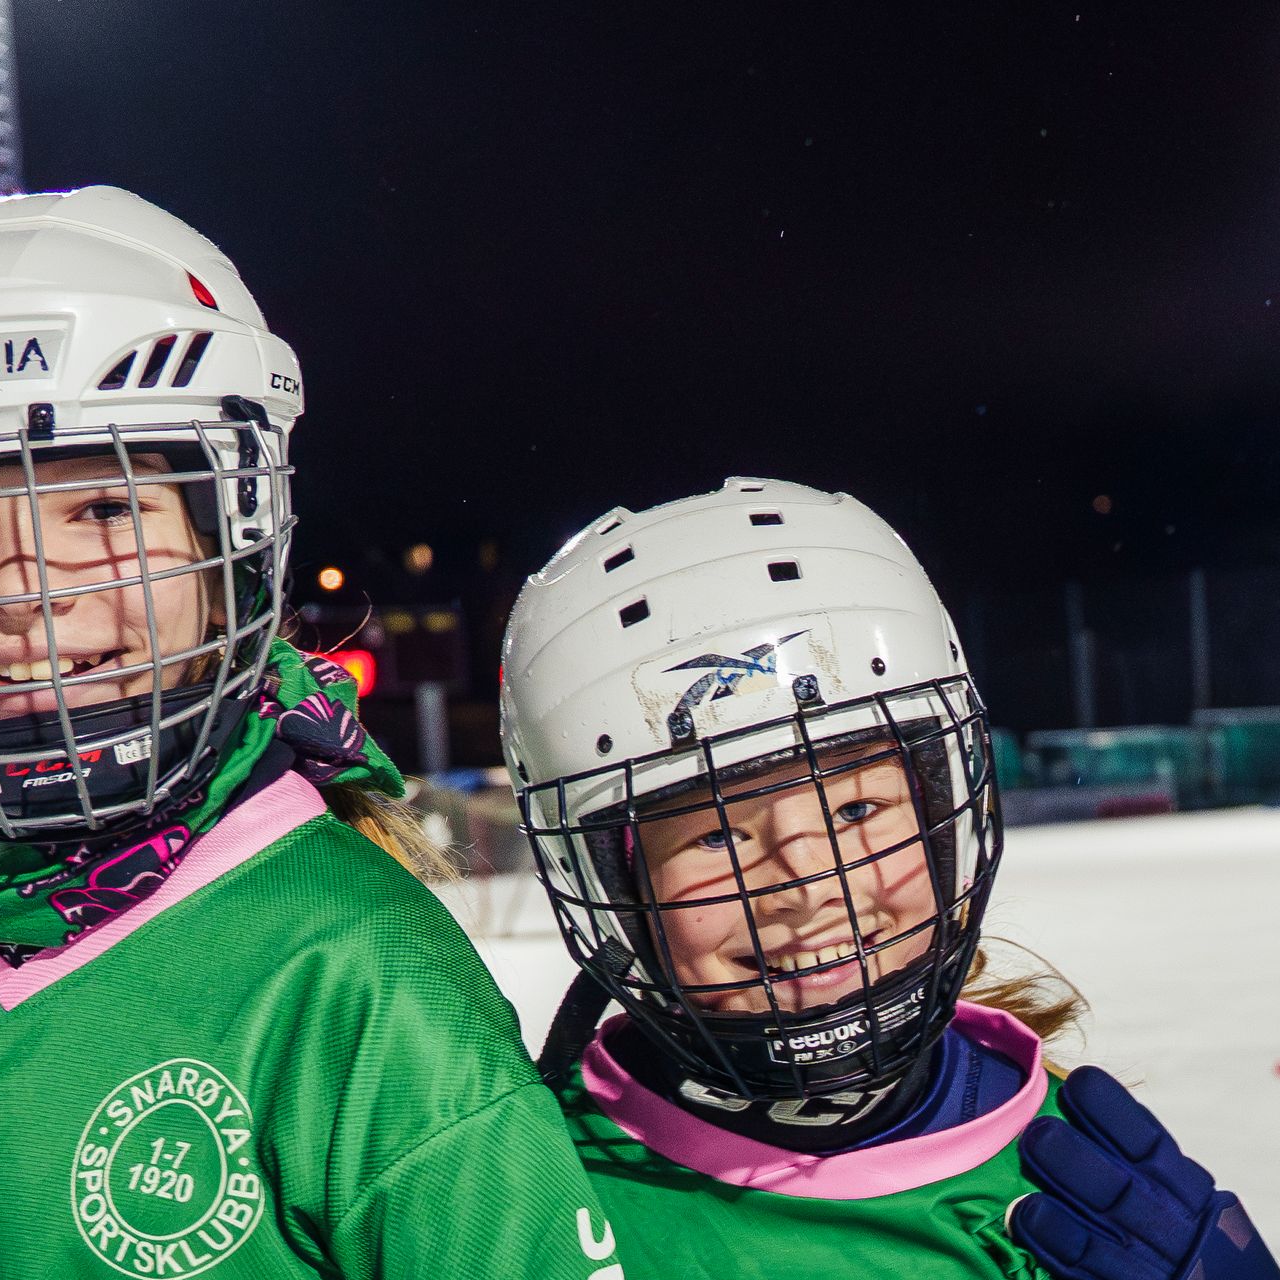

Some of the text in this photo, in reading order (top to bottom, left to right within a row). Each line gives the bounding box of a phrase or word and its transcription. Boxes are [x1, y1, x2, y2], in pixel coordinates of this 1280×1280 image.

[270, 372, 300, 396] CCM
[106, 1066, 252, 1155] SNARØYA
[150, 1136, 192, 1170] 1-7
[127, 1163, 195, 1203] 1920
[77, 1143, 260, 1275] SPORTSKLUBB
